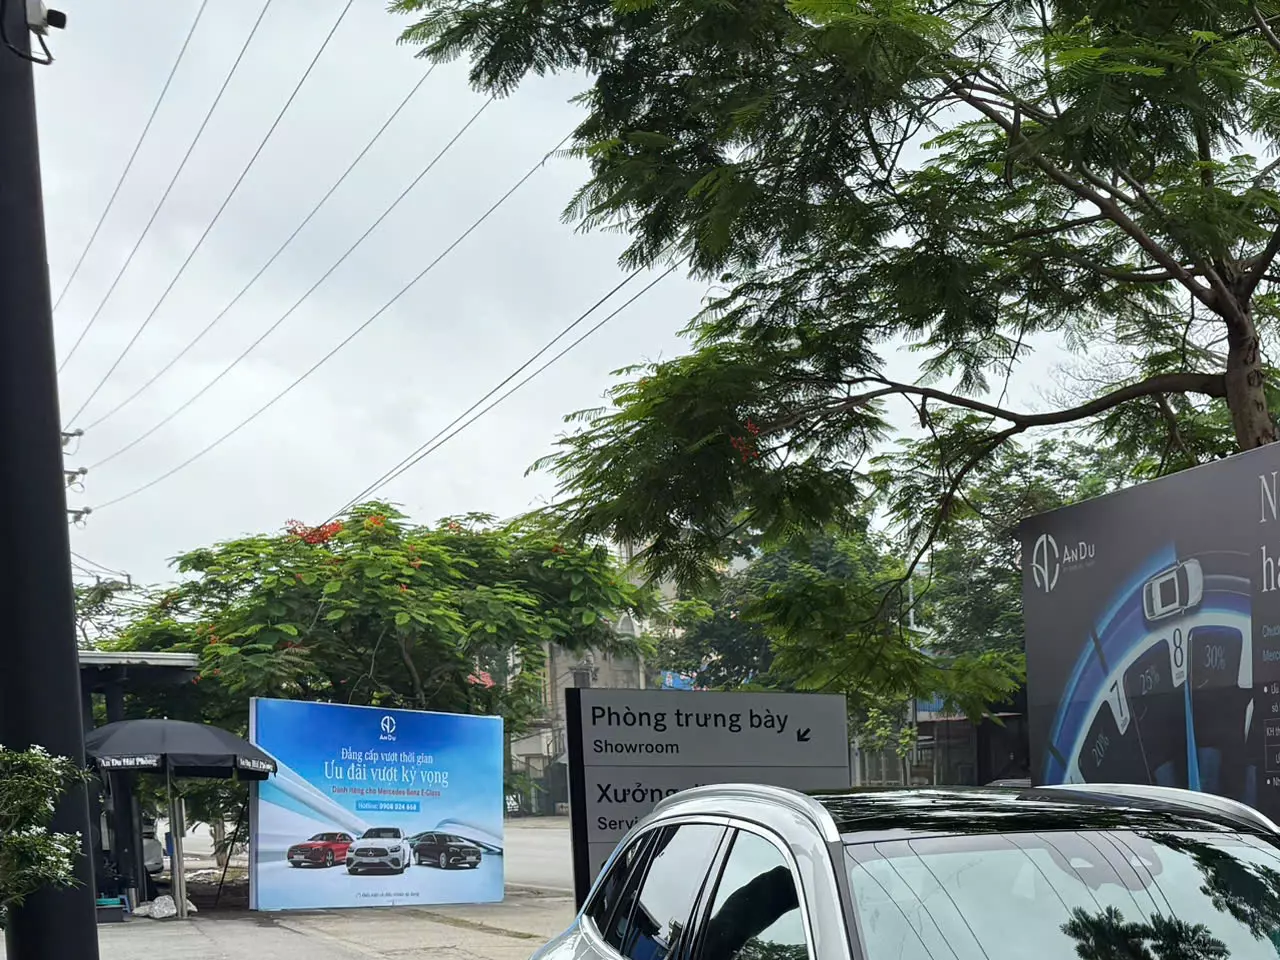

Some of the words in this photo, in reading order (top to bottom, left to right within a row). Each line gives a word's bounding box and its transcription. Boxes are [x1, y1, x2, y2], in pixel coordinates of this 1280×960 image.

[1173, 628, 1183, 668] 8
[1205, 644, 1226, 670] 30%
[591, 706, 667, 732] Phòng
[674, 709, 742, 732] trưng
[750, 709, 789, 734] bày
[364, 748, 378, 763] cấp
[416, 752, 433, 766] gian
[593, 739, 680, 754] Showroom
[324, 760, 343, 780] Ưu
[347, 764, 366, 781] đãi
[371, 767, 398, 786] vượt
[421, 770, 448, 788] vọng
[598, 816, 640, 831] Servi
